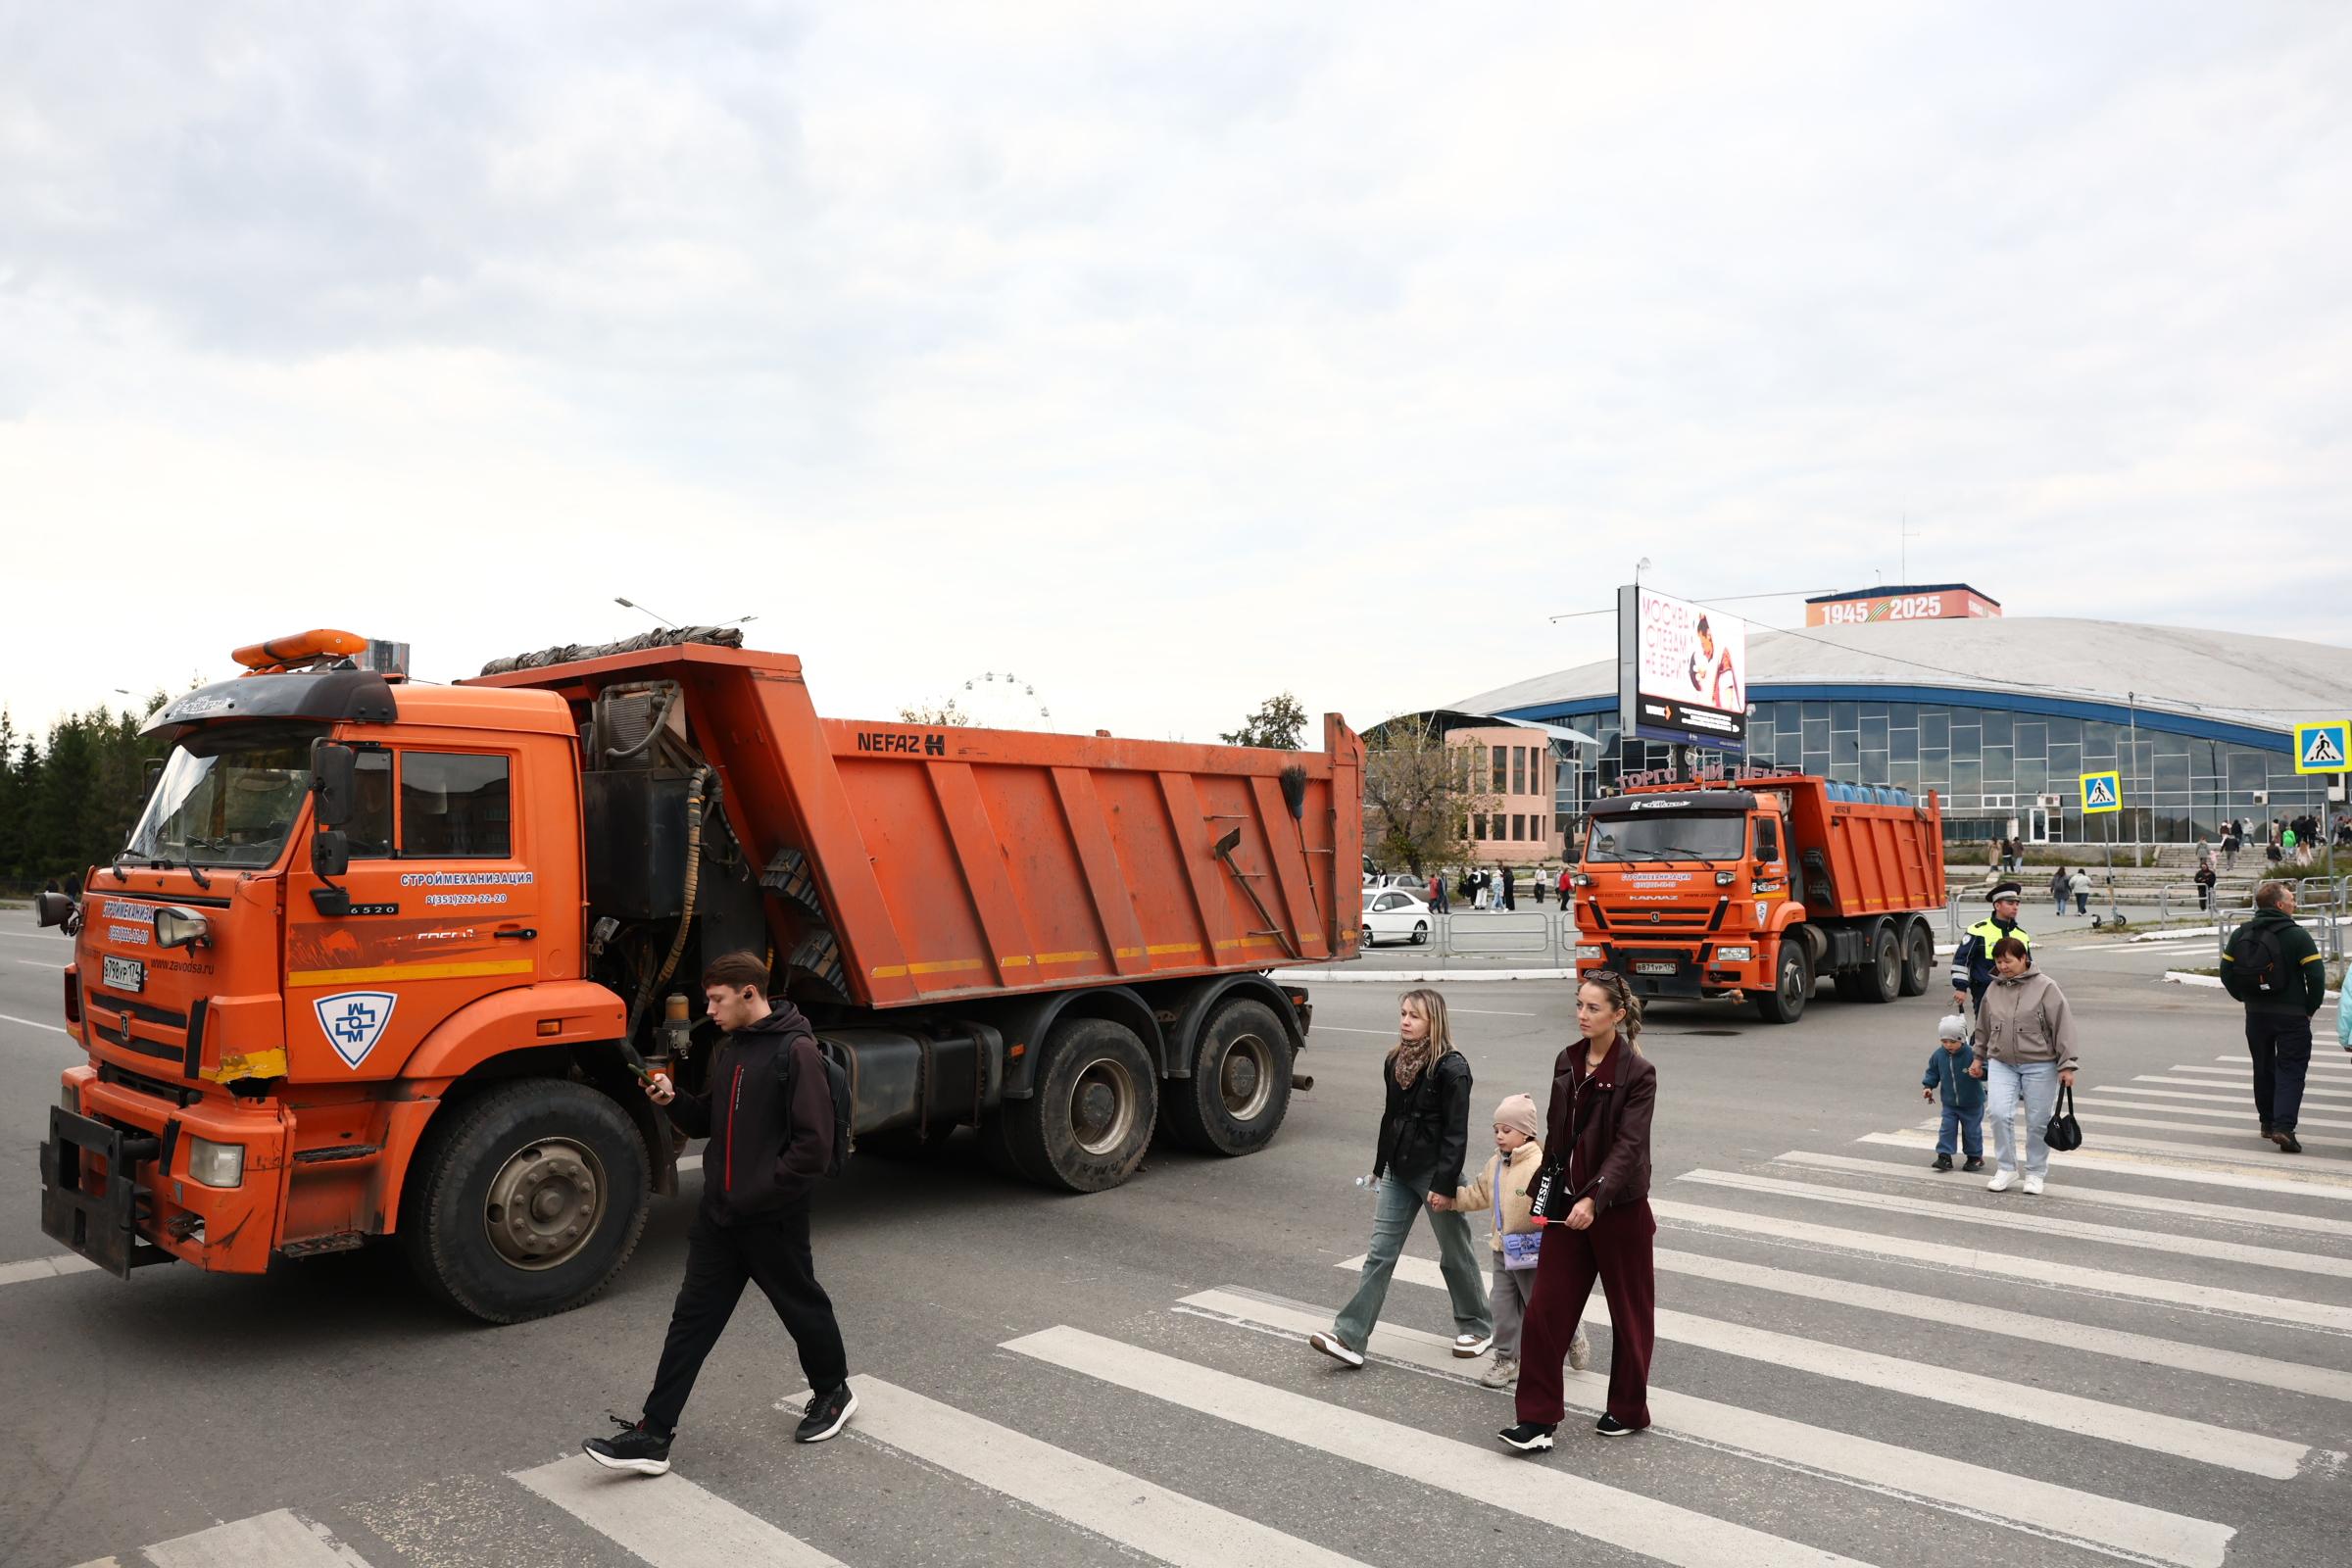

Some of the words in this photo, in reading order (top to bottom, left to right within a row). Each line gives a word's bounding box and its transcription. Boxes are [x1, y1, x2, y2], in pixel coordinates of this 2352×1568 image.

[1821, 602, 1869, 625] 1945
[1889, 595, 1941, 619] 2025
[858, 733, 920, 753] NEFAZ
[1615, 759, 1724, 791] ТОРГОЫЙ
[401, 871, 533, 886] СТРОЙМЕХАНИЗАЦИЯ
[425, 894, 507, 906] 8(351)222-22-20
[103, 900, 155, 924] СТРОЙМЕХАНИЗА
[150, 958, 215, 975] www.zavodsa.ru
[1532, 1176, 1550, 1215] DIESEL
